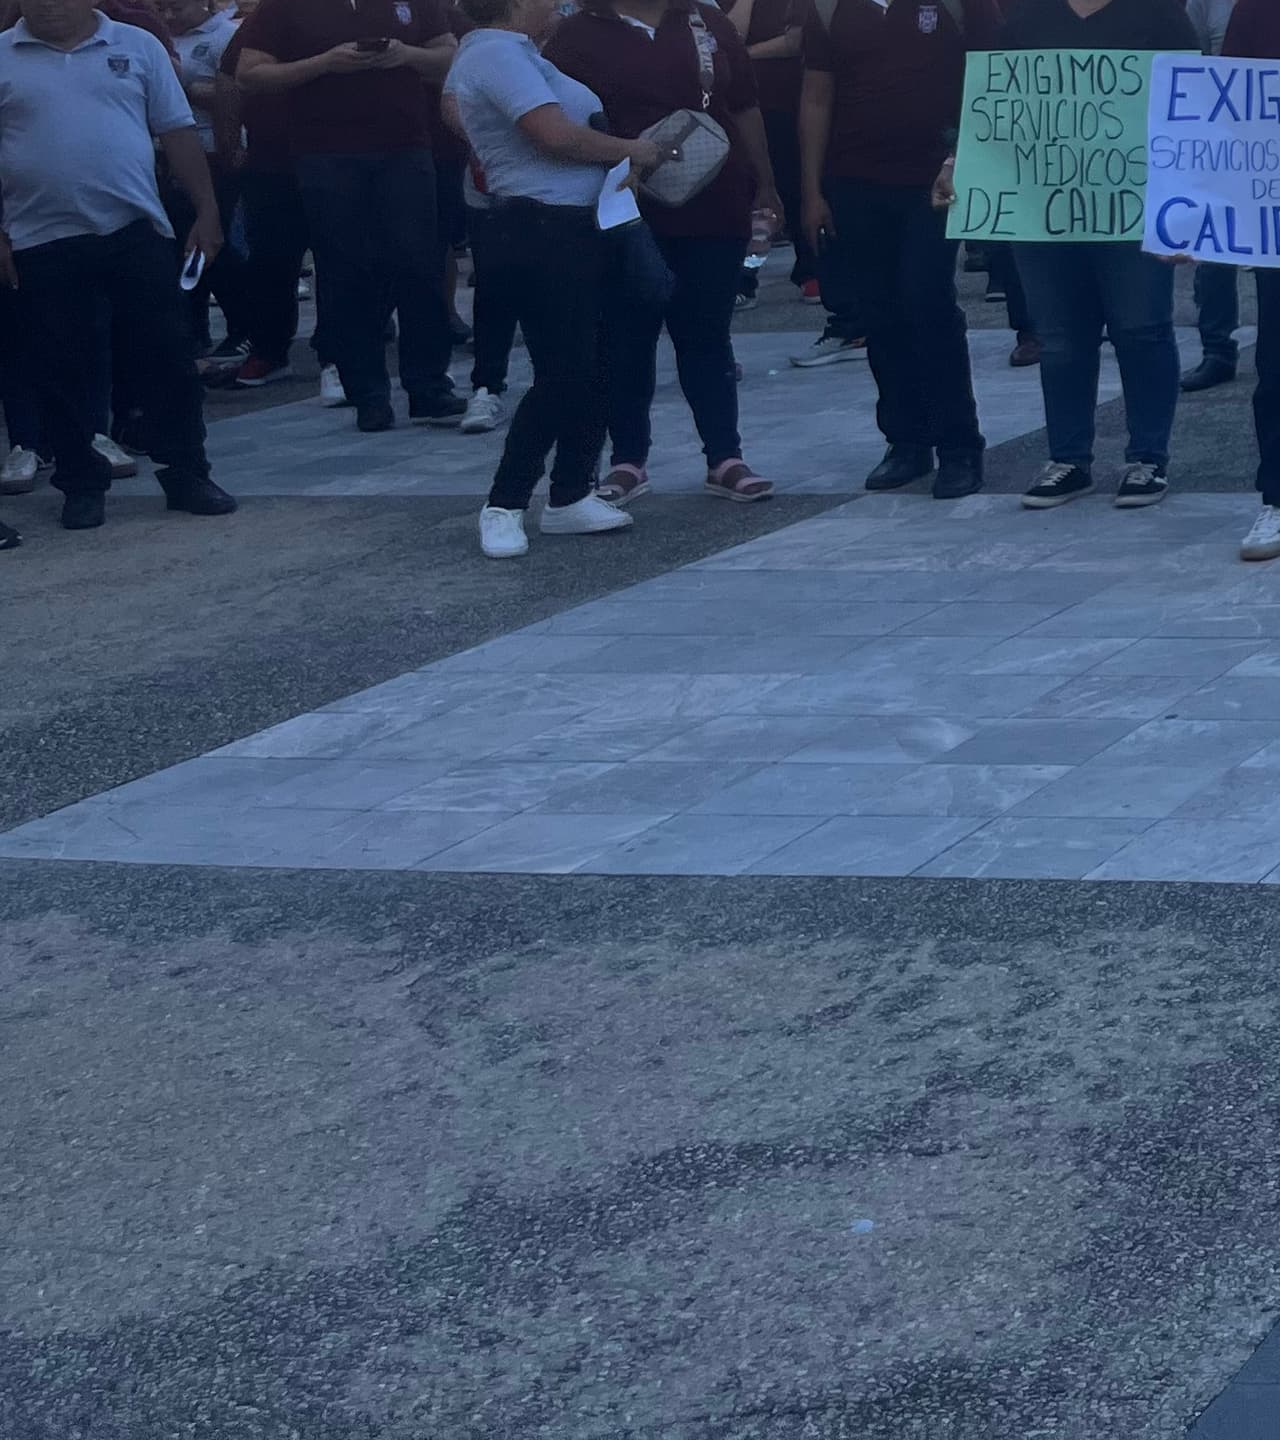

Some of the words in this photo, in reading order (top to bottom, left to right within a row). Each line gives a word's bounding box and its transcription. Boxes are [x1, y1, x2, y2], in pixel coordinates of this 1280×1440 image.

[986, 53, 1142, 95] EXIGIMOS
[971, 96, 1124, 142] SERVICIOS
[1015, 137, 1147, 187] MÉDICOS
[1151, 135, 1280, 173] SERVICIOS
[961, 187, 1018, 235] DE
[1045, 188, 1145, 235] CALID
[1252, 178, 1280, 200] DE
